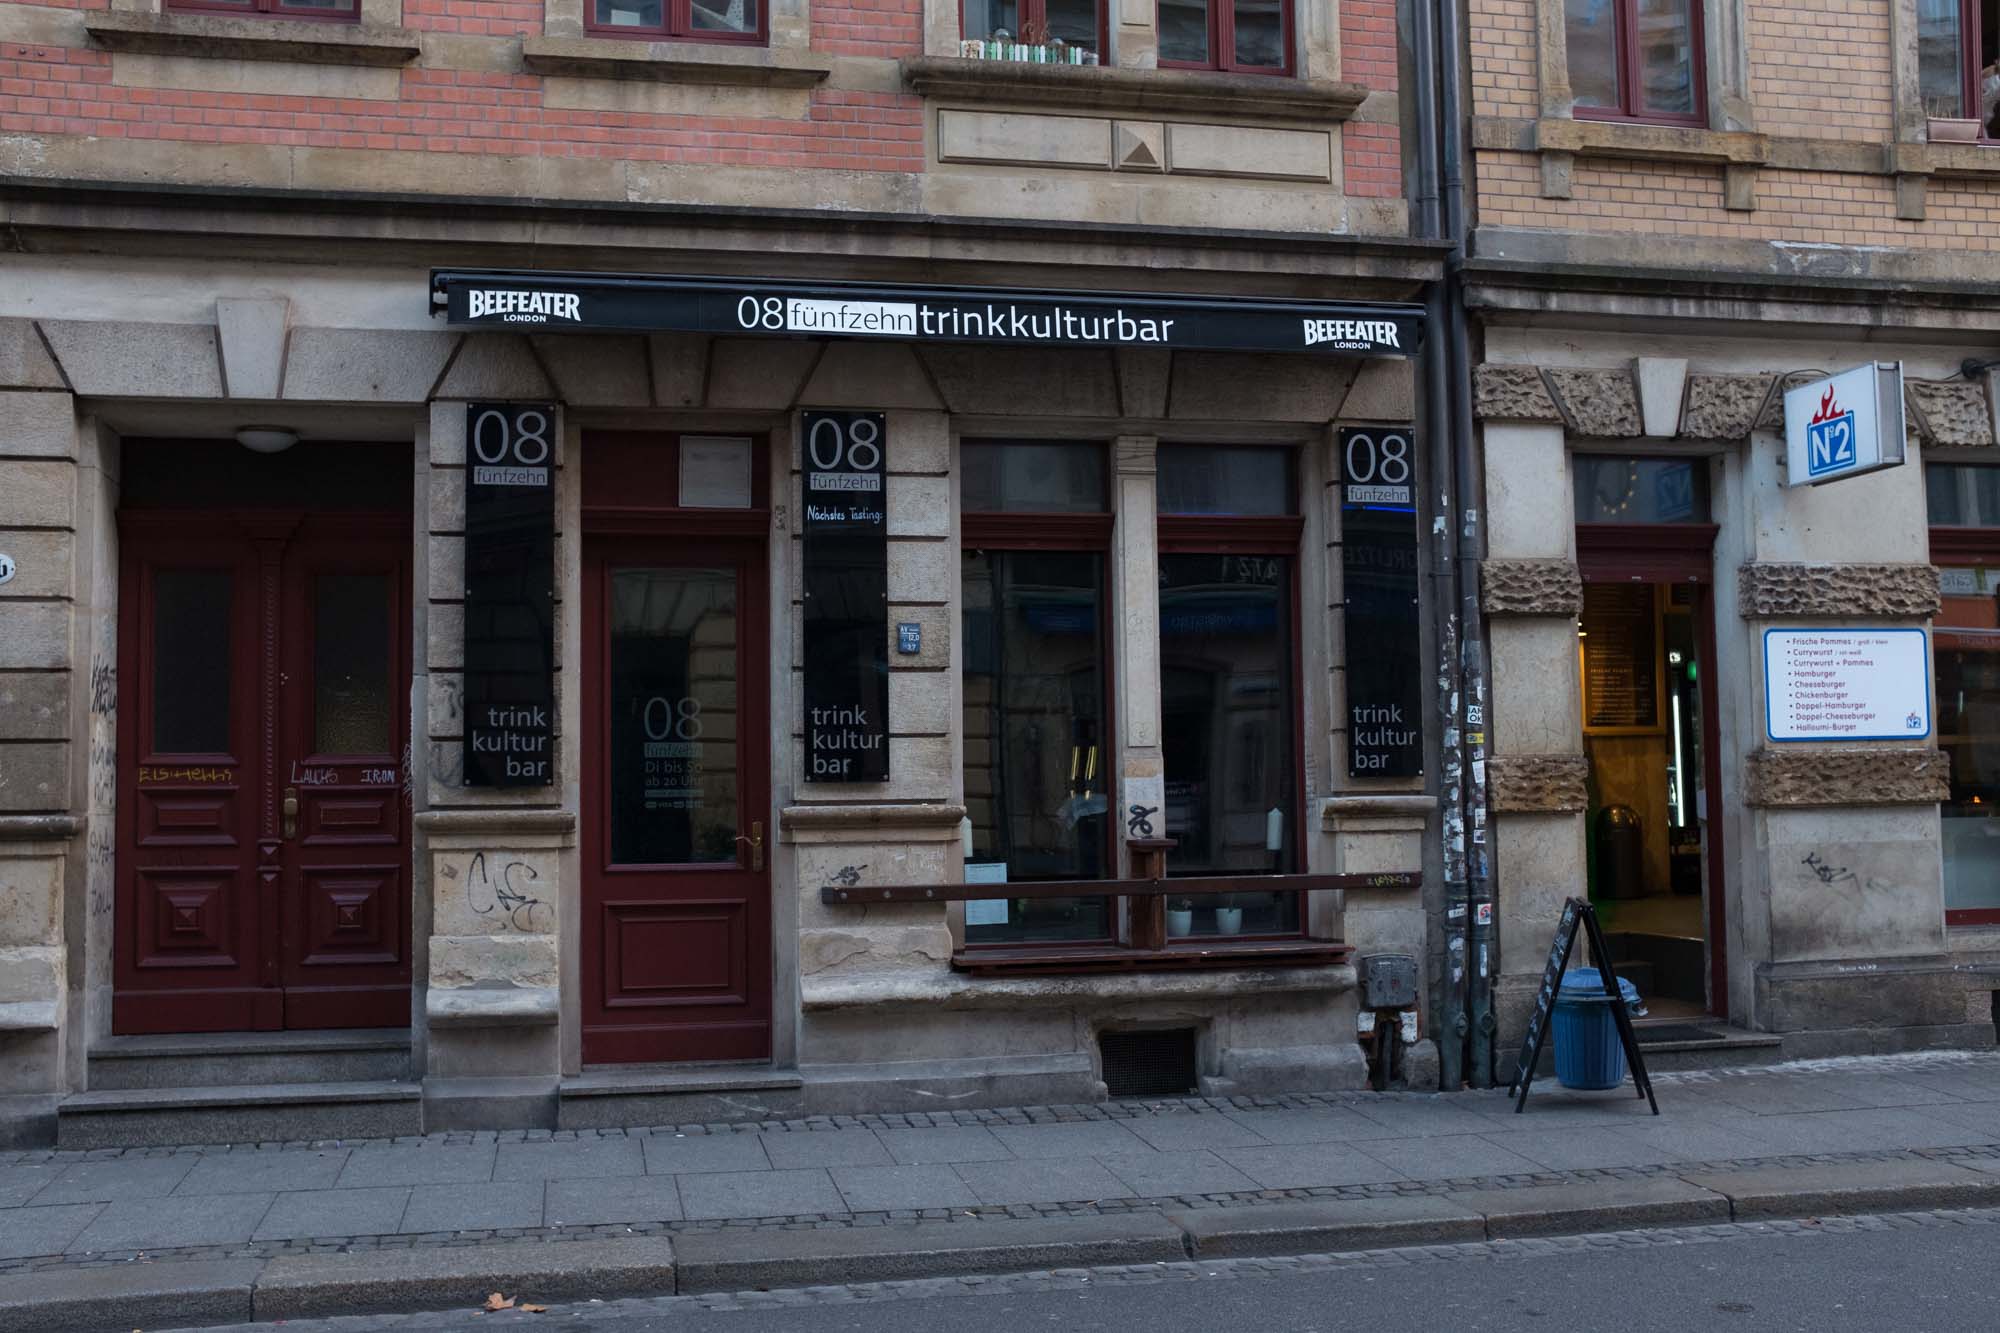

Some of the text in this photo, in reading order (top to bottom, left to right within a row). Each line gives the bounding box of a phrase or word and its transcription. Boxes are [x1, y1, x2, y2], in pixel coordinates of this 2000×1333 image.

[469, 289, 582, 322] BEEFEATER
[503, 314, 547, 323] LONDON
[737, 295, 1174, 342] 08 fünfzehn trinkkulturbar
[1303, 319, 1401, 349] BEEFEATER
[1334, 341, 1371, 350] LONDON
[474, 410, 548, 464] 08
[809, 418, 880, 471] 08
[1346, 433, 1409, 484] 08
[477, 467, 547, 484] fünfzehn
[812, 473, 880, 489] fünfzehn
[1350, 486, 1408, 501] fünfzehn
[1792, 637, 1818, 646] Frische
[1820, 637, 1851, 646] Pommes
[1793, 648, 1833, 657] Currywurst
[1793, 659, 1834, 668] Currywurst
[1842, 658, 1874, 667] Pommes
[1794, 669, 1837, 678] Hamburger
[1794, 680, 1846, 689] Cheeseburger
[1795, 691, 1849, 700] Chickenburger
[811, 704, 868, 726] trink
[1352, 703, 1403, 723] trink
[1795, 702, 1867, 711] Doppel-Hamburger
[487, 705, 547, 728] trink
[643, 696, 703, 740] 08
[1795, 712, 1876, 721] Doppel-Cheeseburger
[1354, 726, 1417, 746] kultur
[1796, 722, 1857, 732] Halloumi-Burger
[472, 729, 547, 752] kultur
[812, 728, 884, 750] kultur
[506, 754, 548, 777] bar
[646, 761, 660, 774] Di
[663, 760, 682, 774] bis
[812, 752, 853, 774] bar
[1355, 749, 1390, 769] bar
[663, 777, 678, 786] 20
